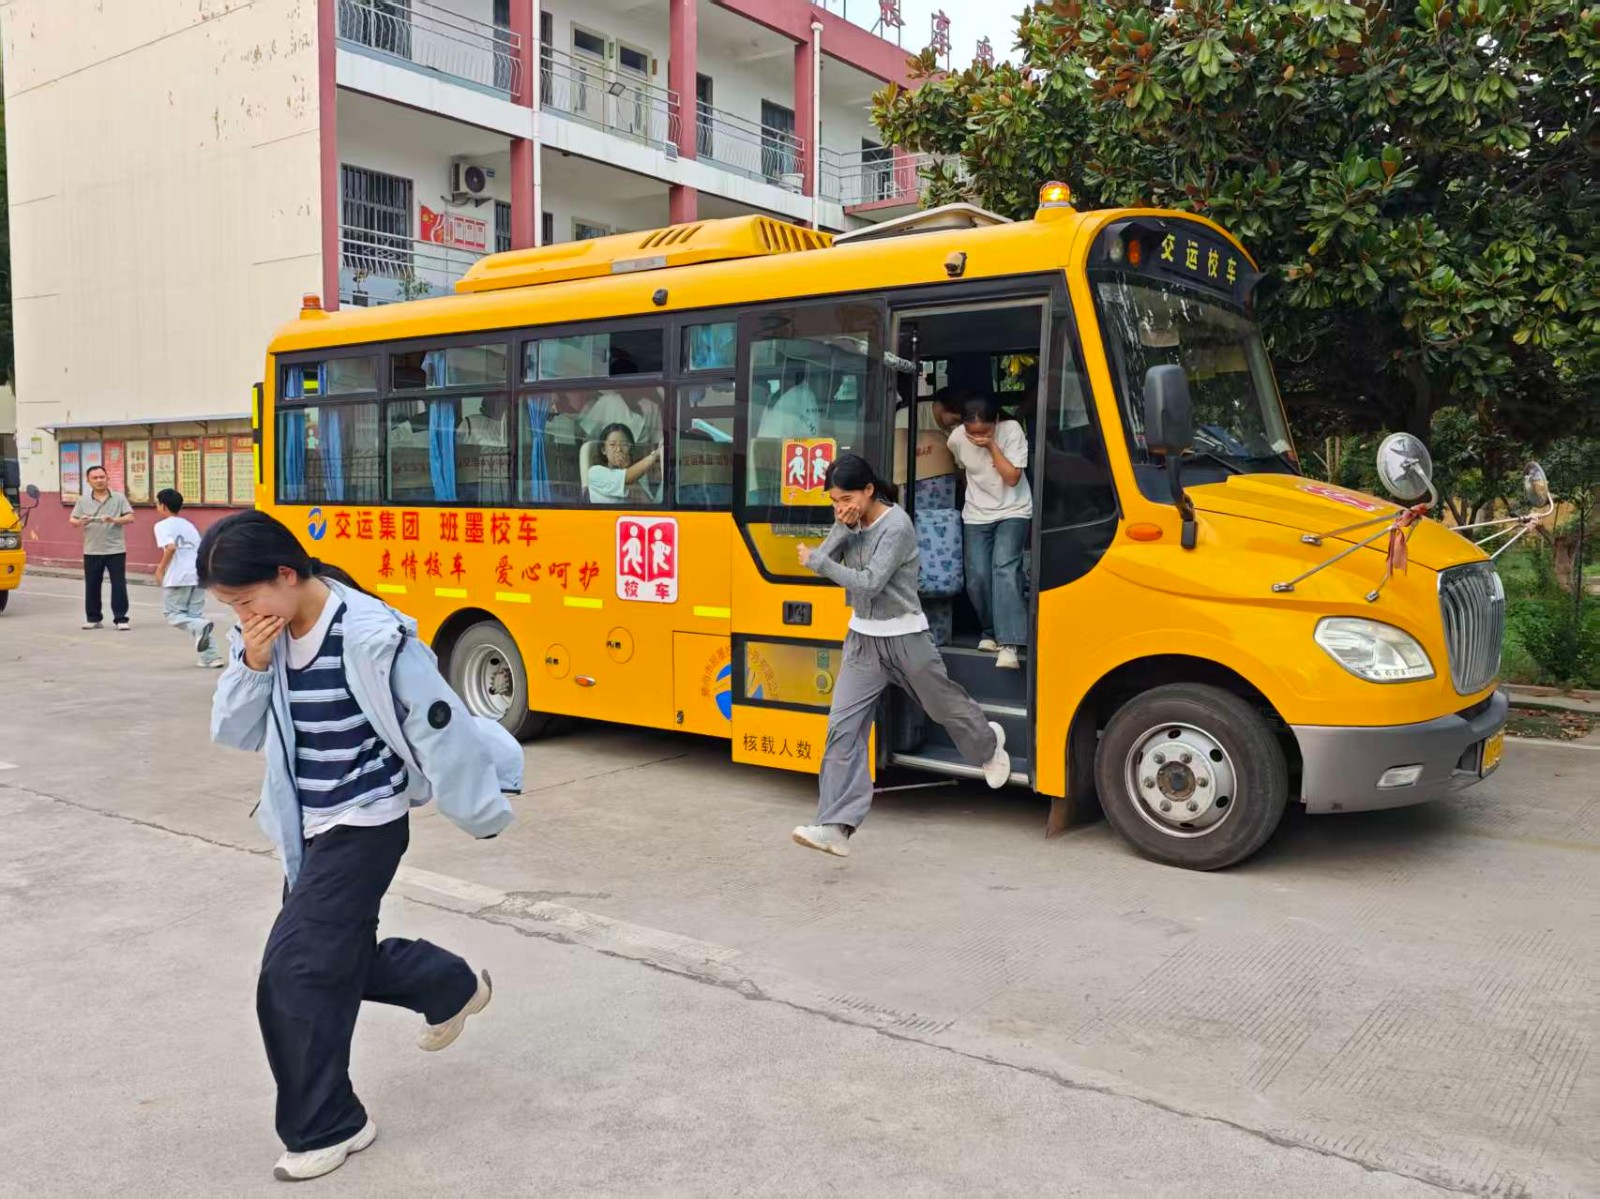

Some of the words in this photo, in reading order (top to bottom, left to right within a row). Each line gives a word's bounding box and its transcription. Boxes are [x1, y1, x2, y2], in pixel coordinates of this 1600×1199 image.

[1161, 233, 1237, 285] 交运校车
[335, 510, 420, 541] 交运集团
[439, 512, 539, 547] 班墨校车
[378, 549, 467, 581] 亲情校车
[495, 555, 600, 591] 爱心呵护
[624, 580, 670, 600] 校车
